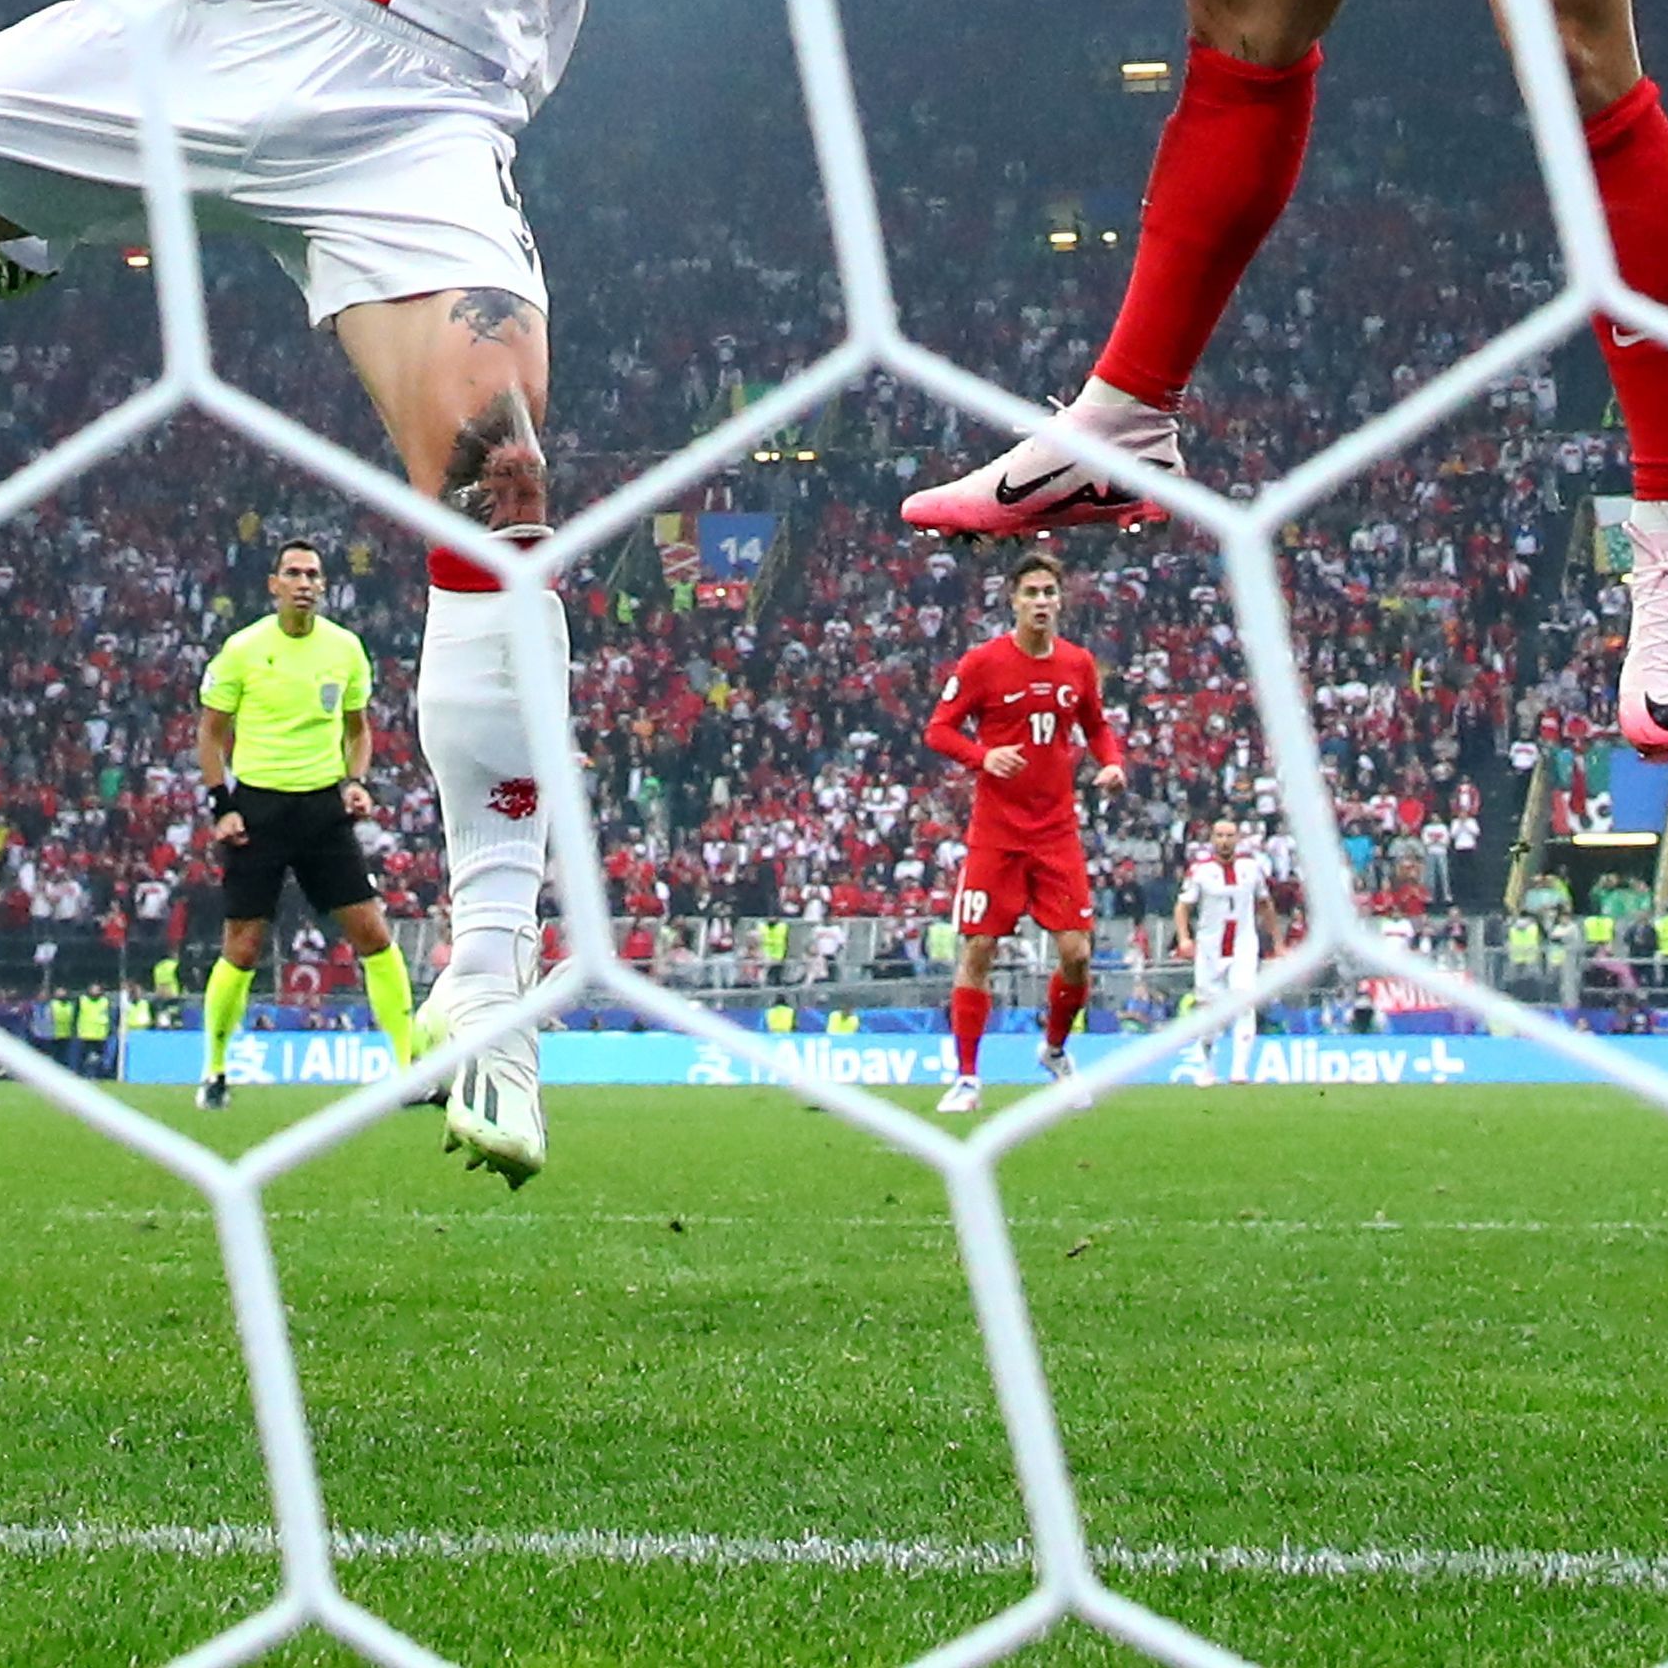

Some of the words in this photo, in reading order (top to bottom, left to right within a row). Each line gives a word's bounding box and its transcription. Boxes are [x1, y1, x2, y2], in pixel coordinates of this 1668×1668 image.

[719, 537, 762, 564] 14
[1029, 712, 1056, 745] 19
[962, 889, 988, 924] 19
